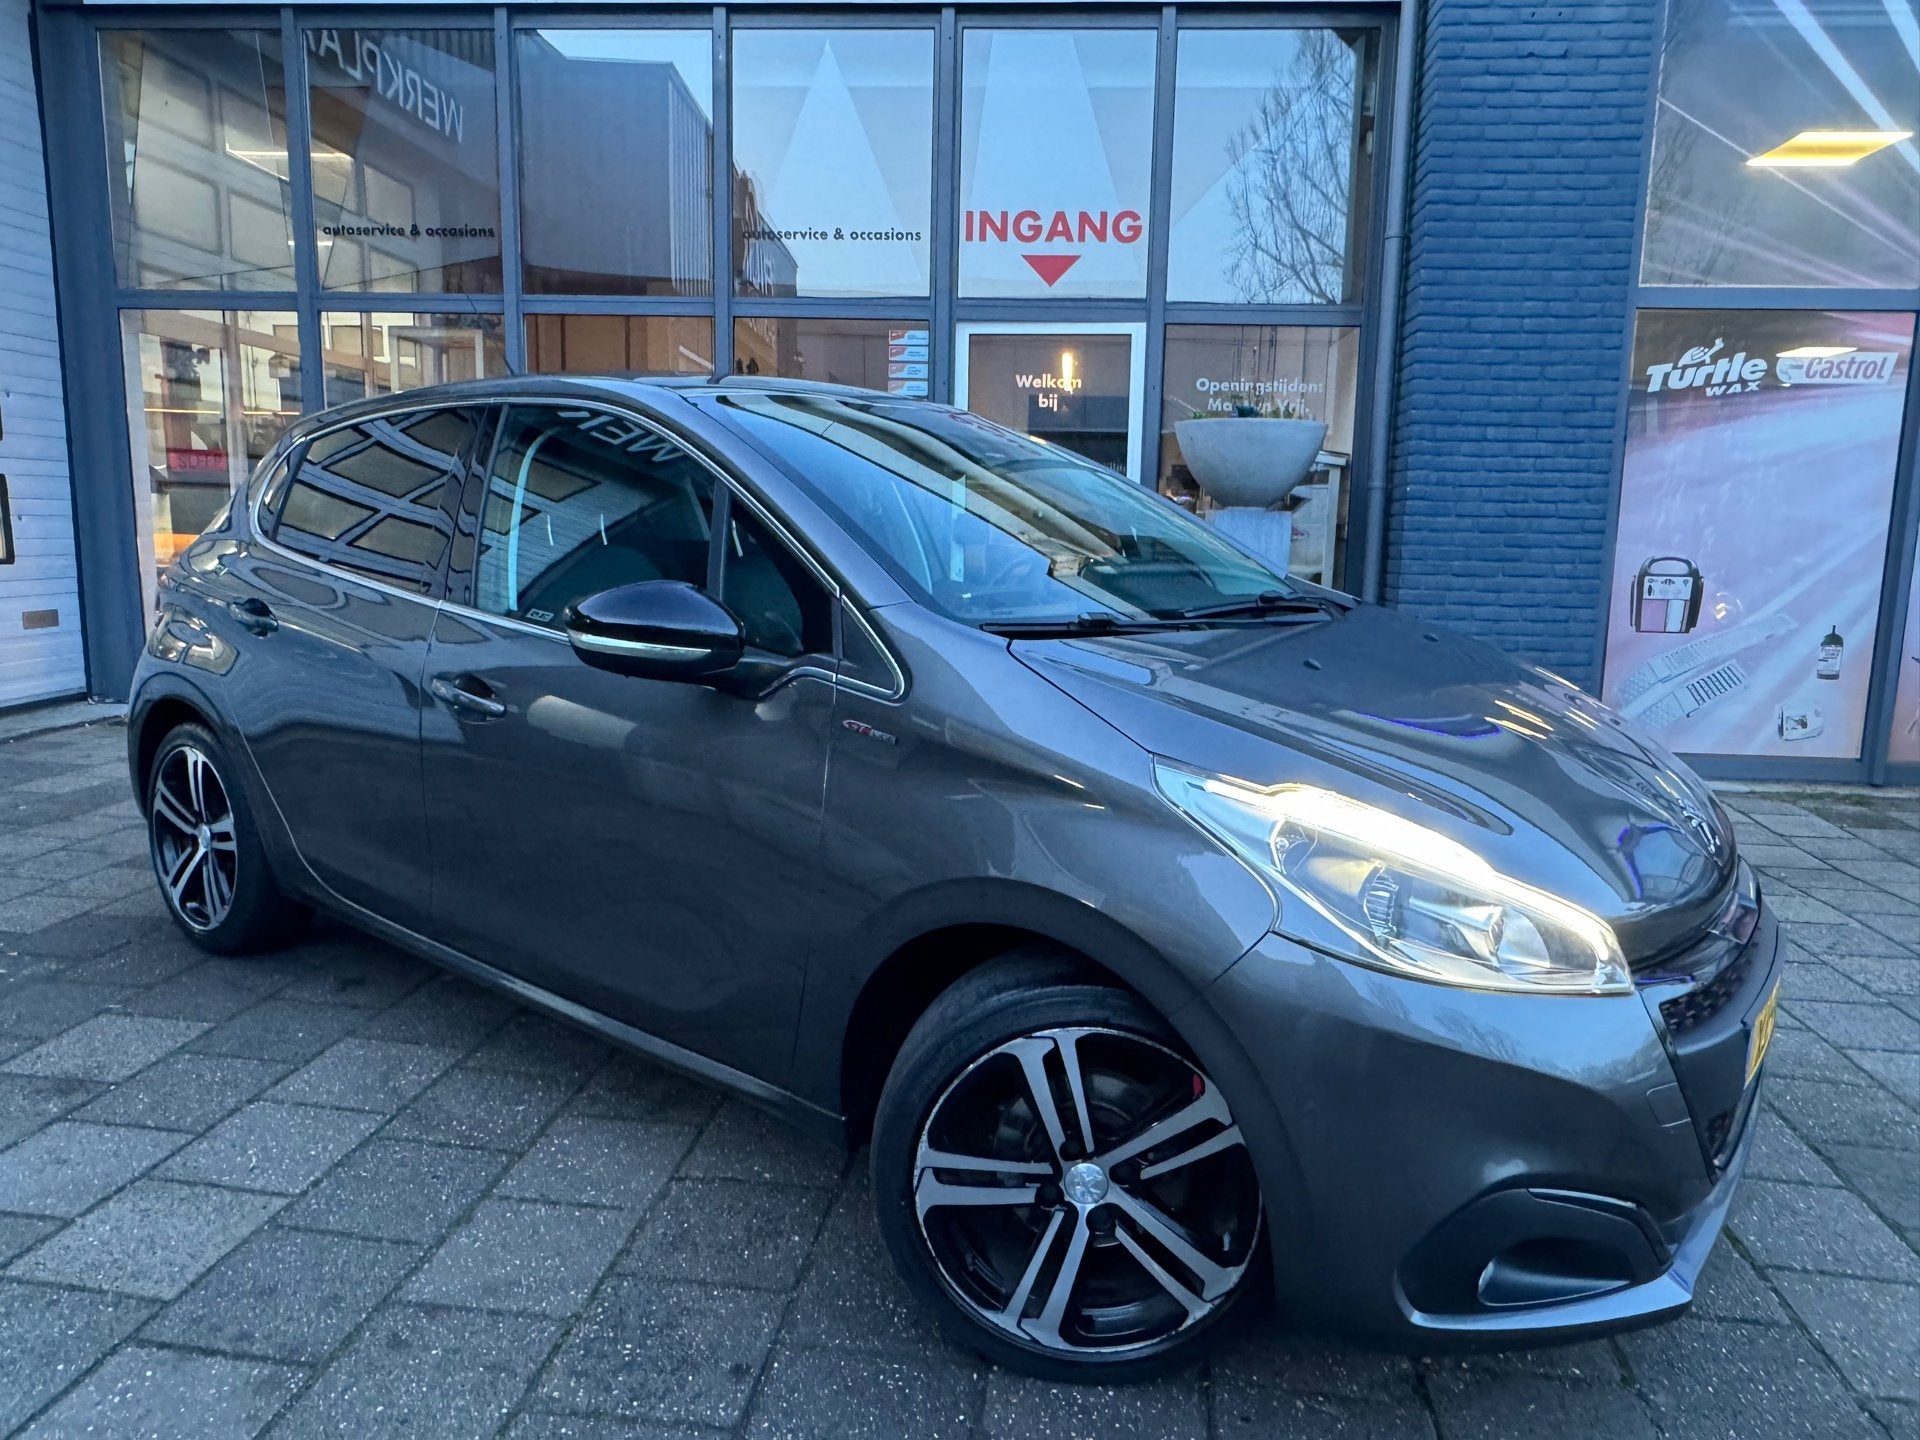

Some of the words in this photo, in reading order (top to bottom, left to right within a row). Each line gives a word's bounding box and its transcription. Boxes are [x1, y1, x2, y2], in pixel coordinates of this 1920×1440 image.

[322, 223, 405, 236] autoservice
[410, 223, 421, 237] &
[425, 224, 496, 238] occasions
[742, 227, 828, 240] autoservice
[833, 227, 845, 240] &
[850, 228, 922, 241] occasions
[965, 210, 1143, 243] INGANG
[1646, 352, 1768, 393] Turtle
[1804, 356, 1888, 380] Castrol
[1015, 374, 1082, 388] Welkom
[1706, 381, 1760, 397] WAX
[1038, 393, 1058, 412] bij
